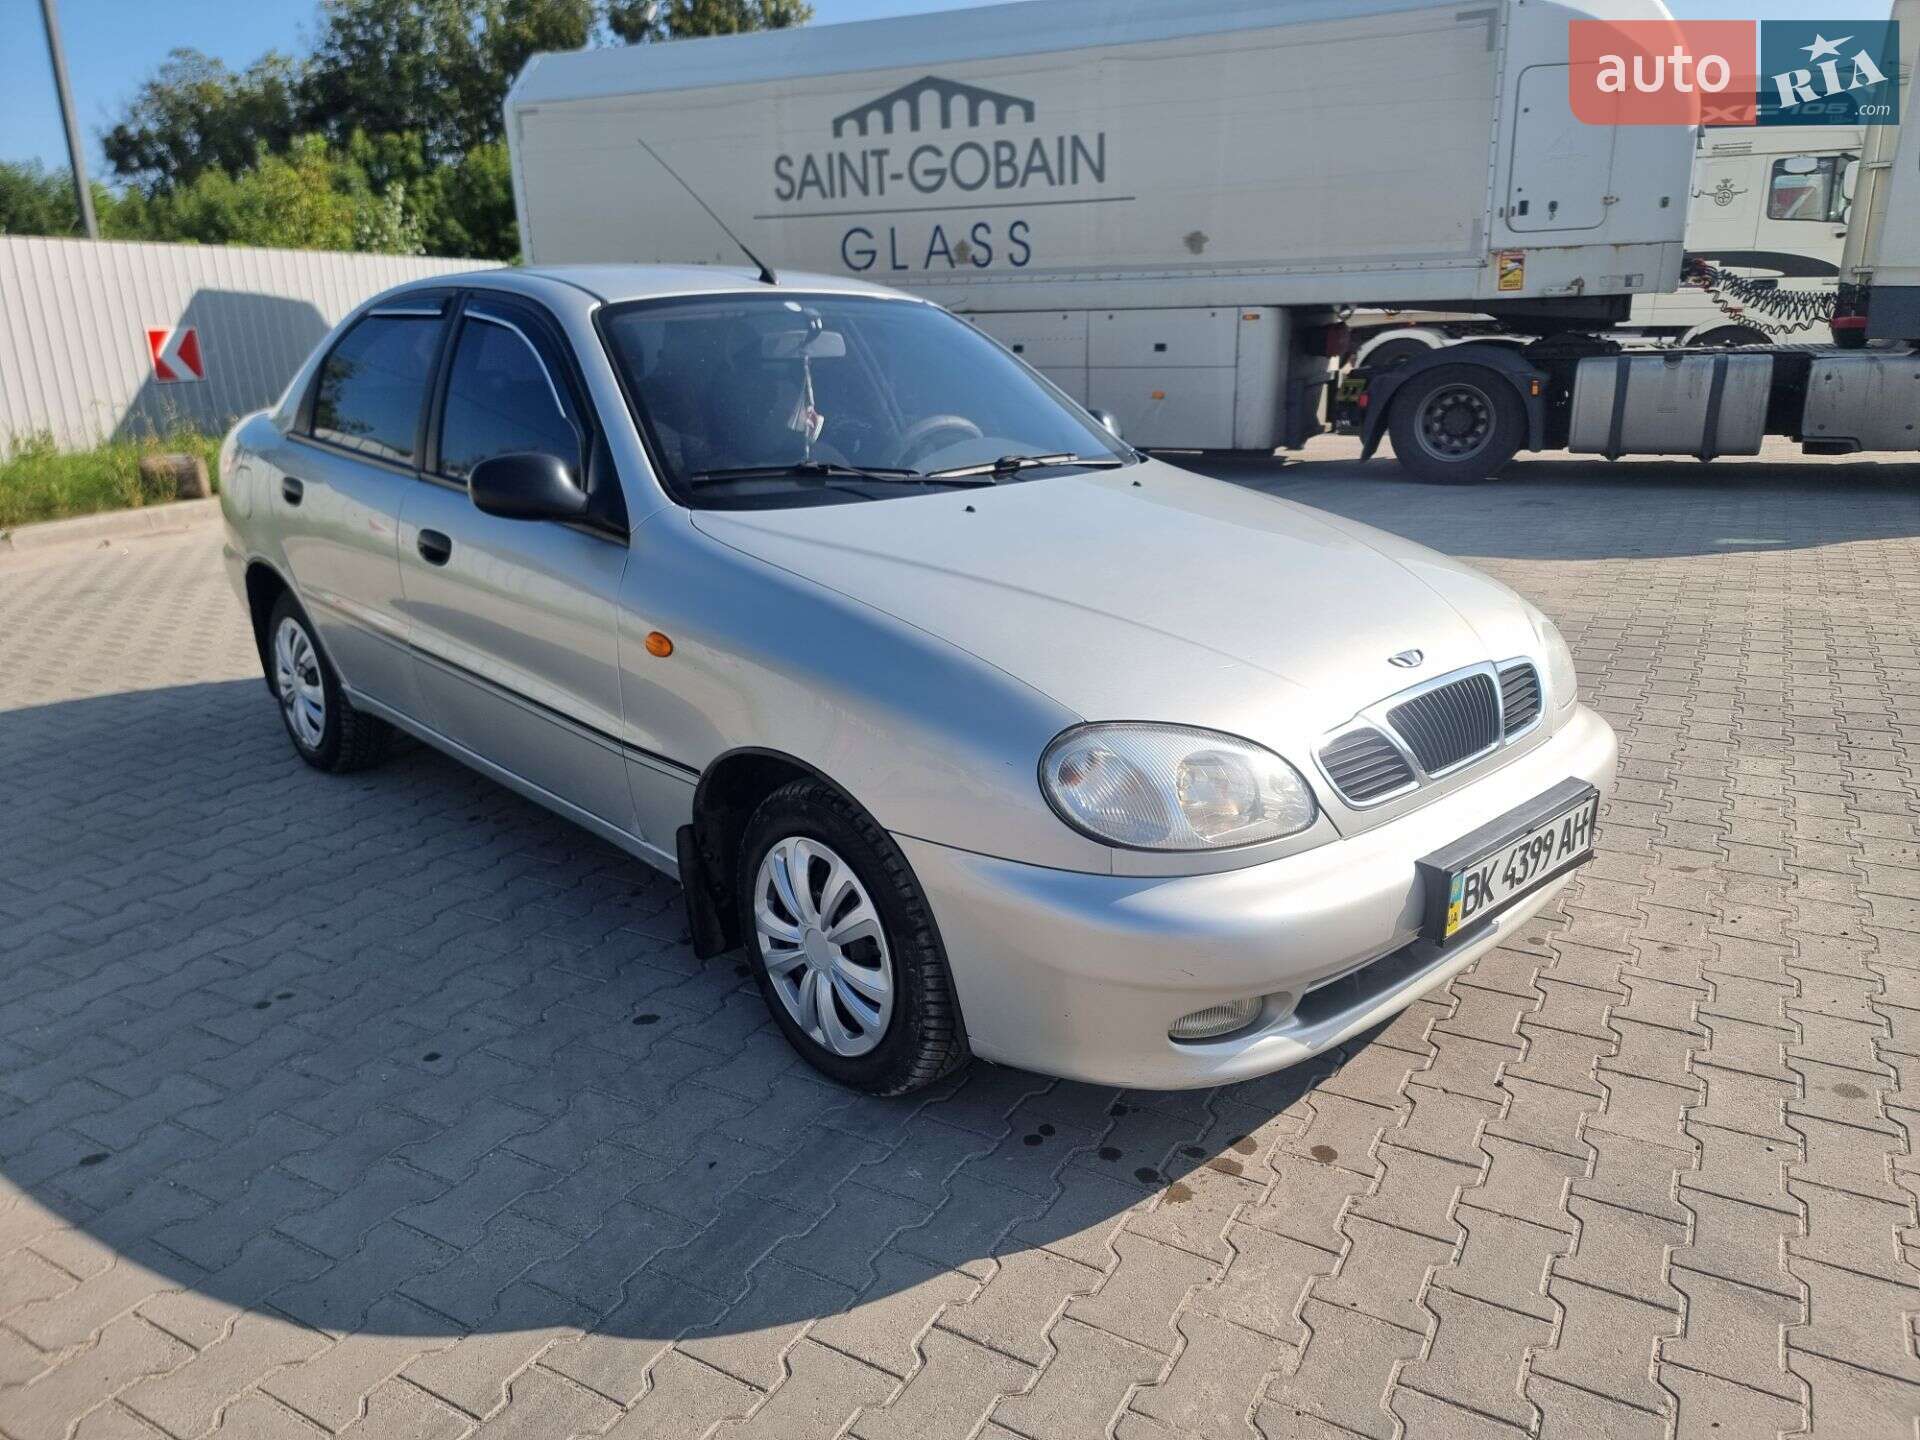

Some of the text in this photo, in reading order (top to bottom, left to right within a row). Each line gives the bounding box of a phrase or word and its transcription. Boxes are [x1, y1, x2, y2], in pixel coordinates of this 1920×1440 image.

[774, 132, 1106, 201] SAINT-GOBAIN
[841, 220, 1032, 272] GLASS
[1461, 806, 1590, 920] BK 4399 AH
